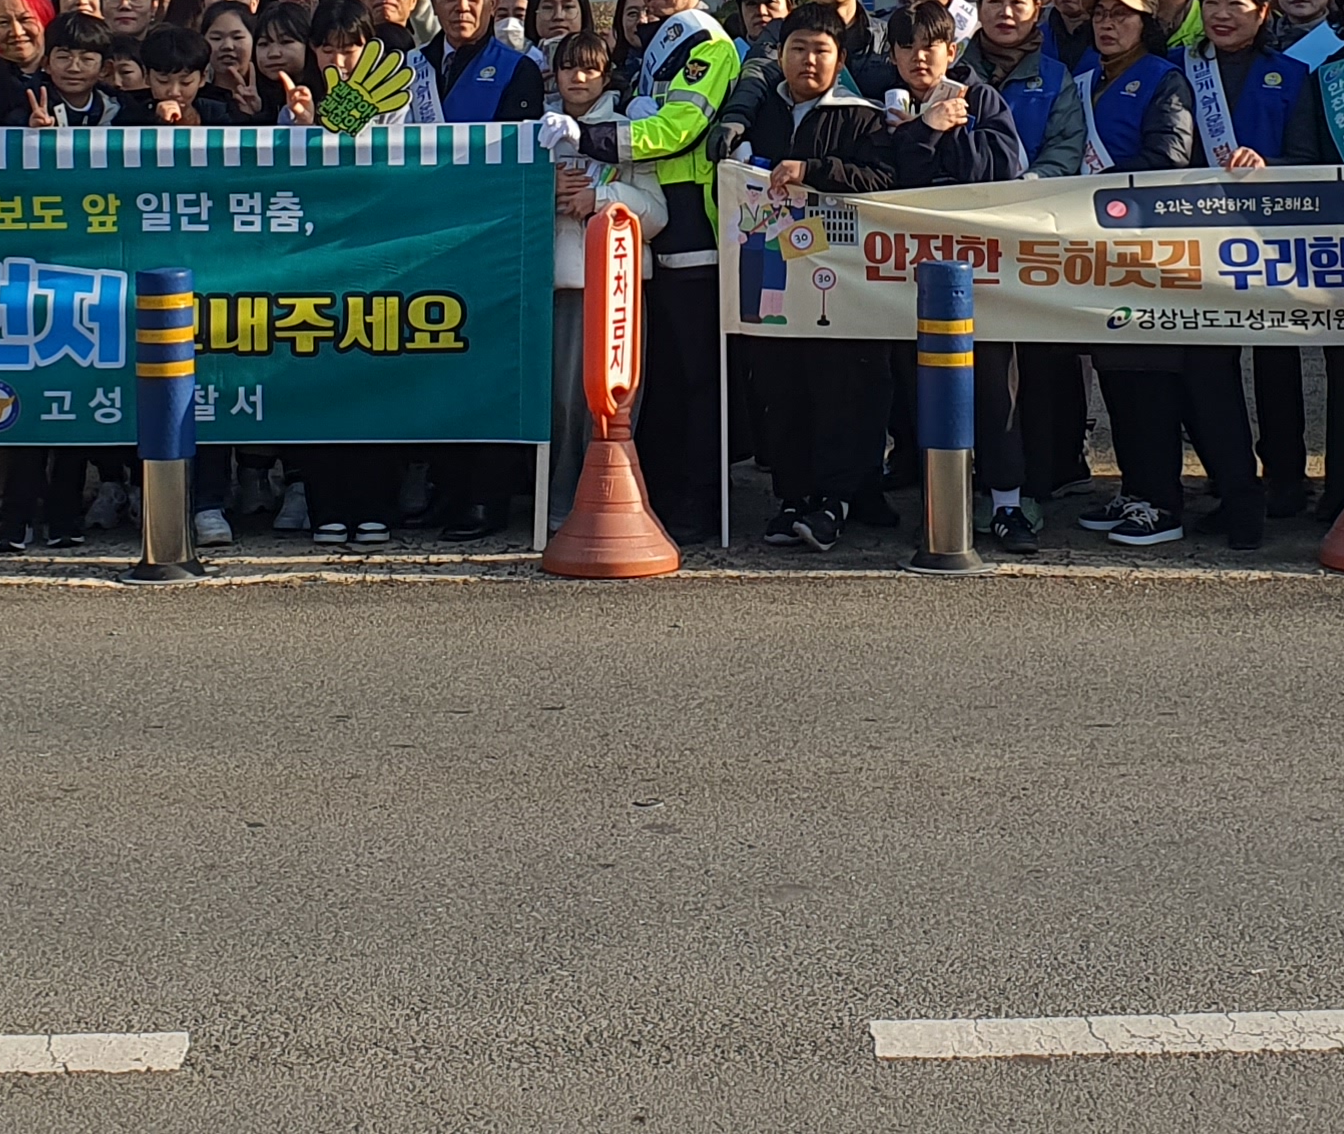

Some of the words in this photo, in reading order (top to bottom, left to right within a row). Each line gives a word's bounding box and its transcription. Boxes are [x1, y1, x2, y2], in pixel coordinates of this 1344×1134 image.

[82, 193, 121, 233] 앞
[135, 192, 214, 233] 일단
[228, 191, 314, 236] 멈춤,
[1153, 197, 1194, 216] 우리는
[1196, 196, 1257, 215] 안전하게
[1259, 195, 1321, 214] 등교해요!
[817, 273, 832, 284] 30
[1015, 238, 1204, 291] 등하굣길
[609, 237, 629, 374] 주차금지
[39, 385, 265, 425] 고성찰서
